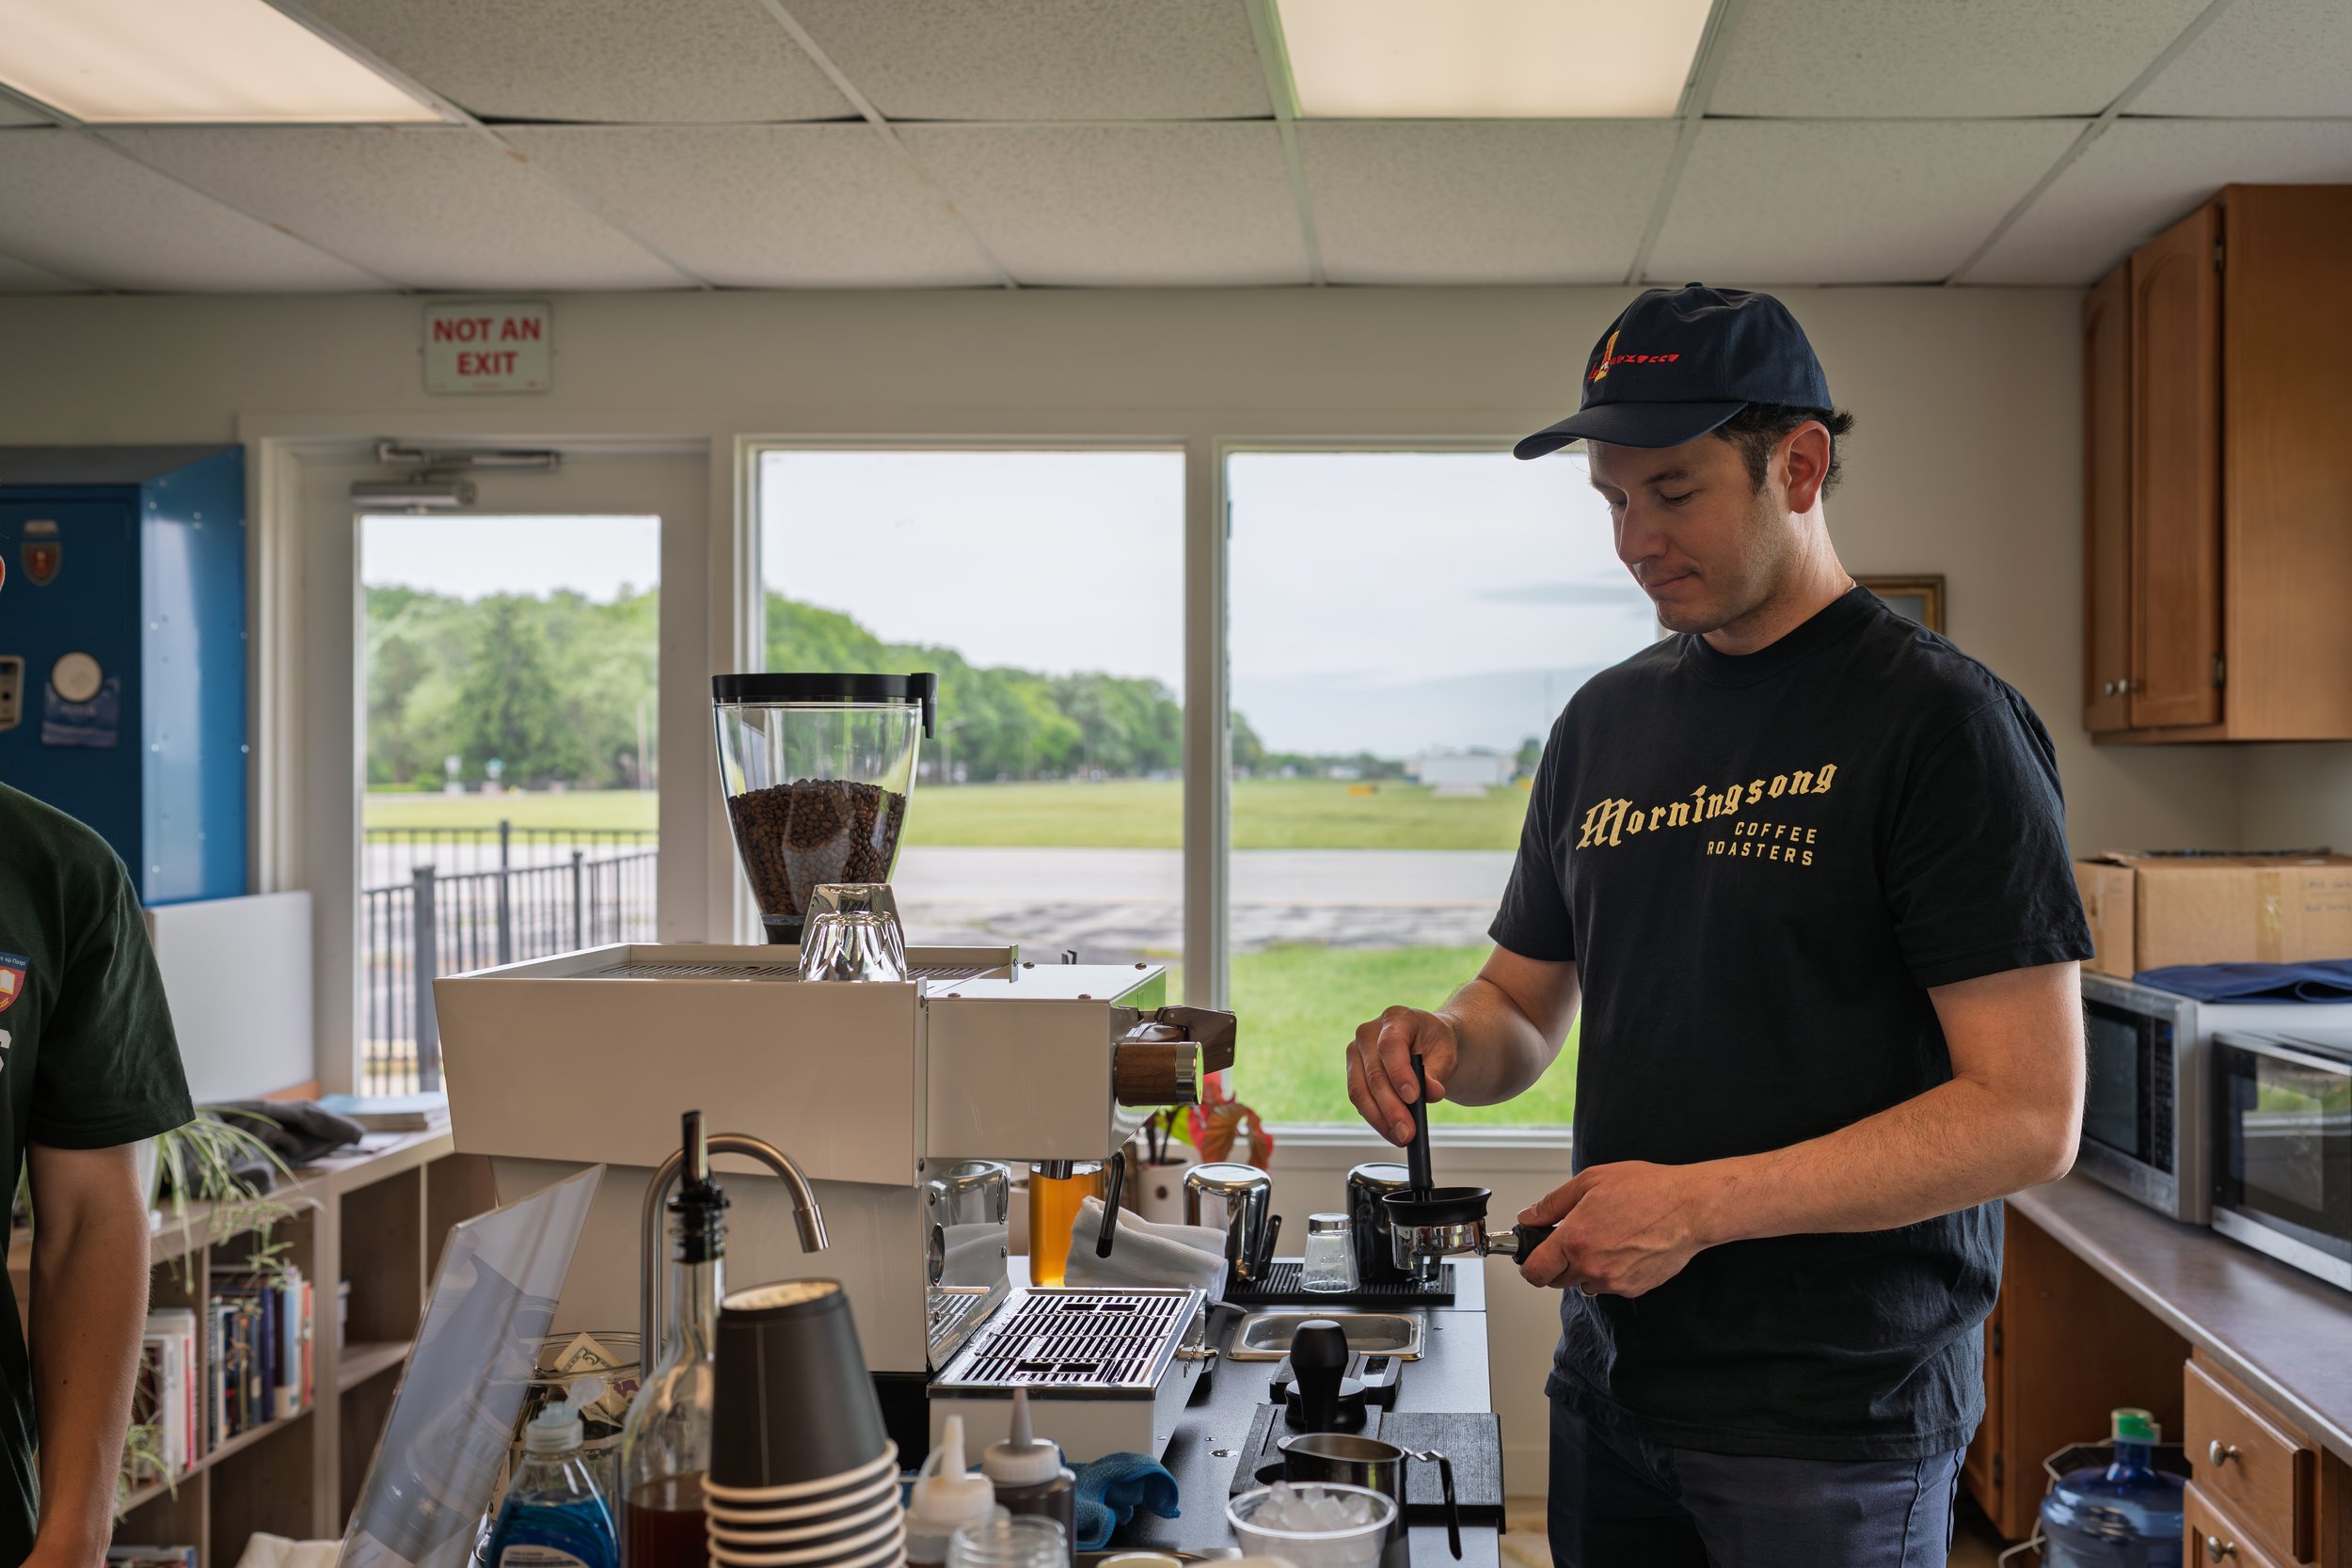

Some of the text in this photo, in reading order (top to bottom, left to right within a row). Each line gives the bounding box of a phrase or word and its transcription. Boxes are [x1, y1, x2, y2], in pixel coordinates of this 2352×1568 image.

[434, 316, 541, 342] NOT AN
[456, 351, 518, 376] EXIT
[1608, 354, 1680, 366] arzocco
[1576, 763, 1837, 850] Morningsong
[1735, 821, 1818, 845] COFFEE
[1707, 840, 1814, 866] ROASTERS
[579, 1347, 599, 1366] 5
